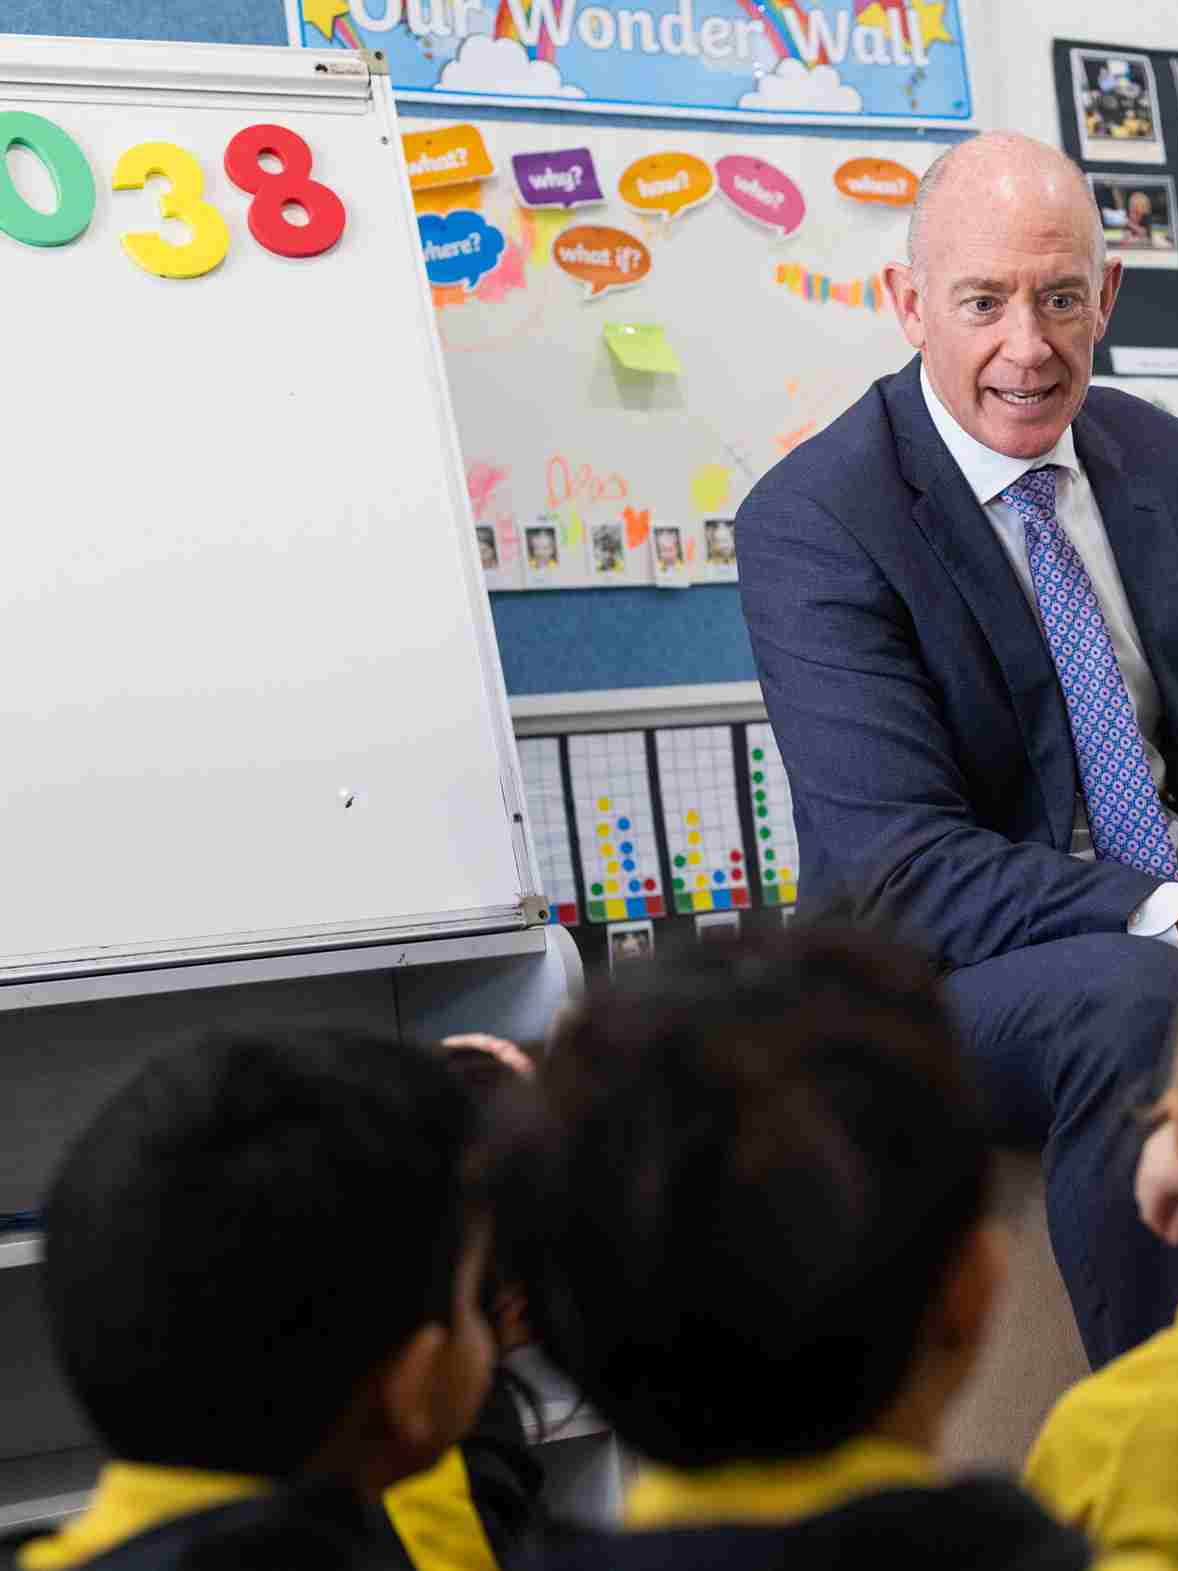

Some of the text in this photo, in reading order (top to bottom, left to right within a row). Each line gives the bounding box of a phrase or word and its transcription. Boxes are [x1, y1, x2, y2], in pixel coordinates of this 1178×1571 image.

[347, 0, 930, 66] Our Wonder Wall
[528, 165, 583, 192] why?
